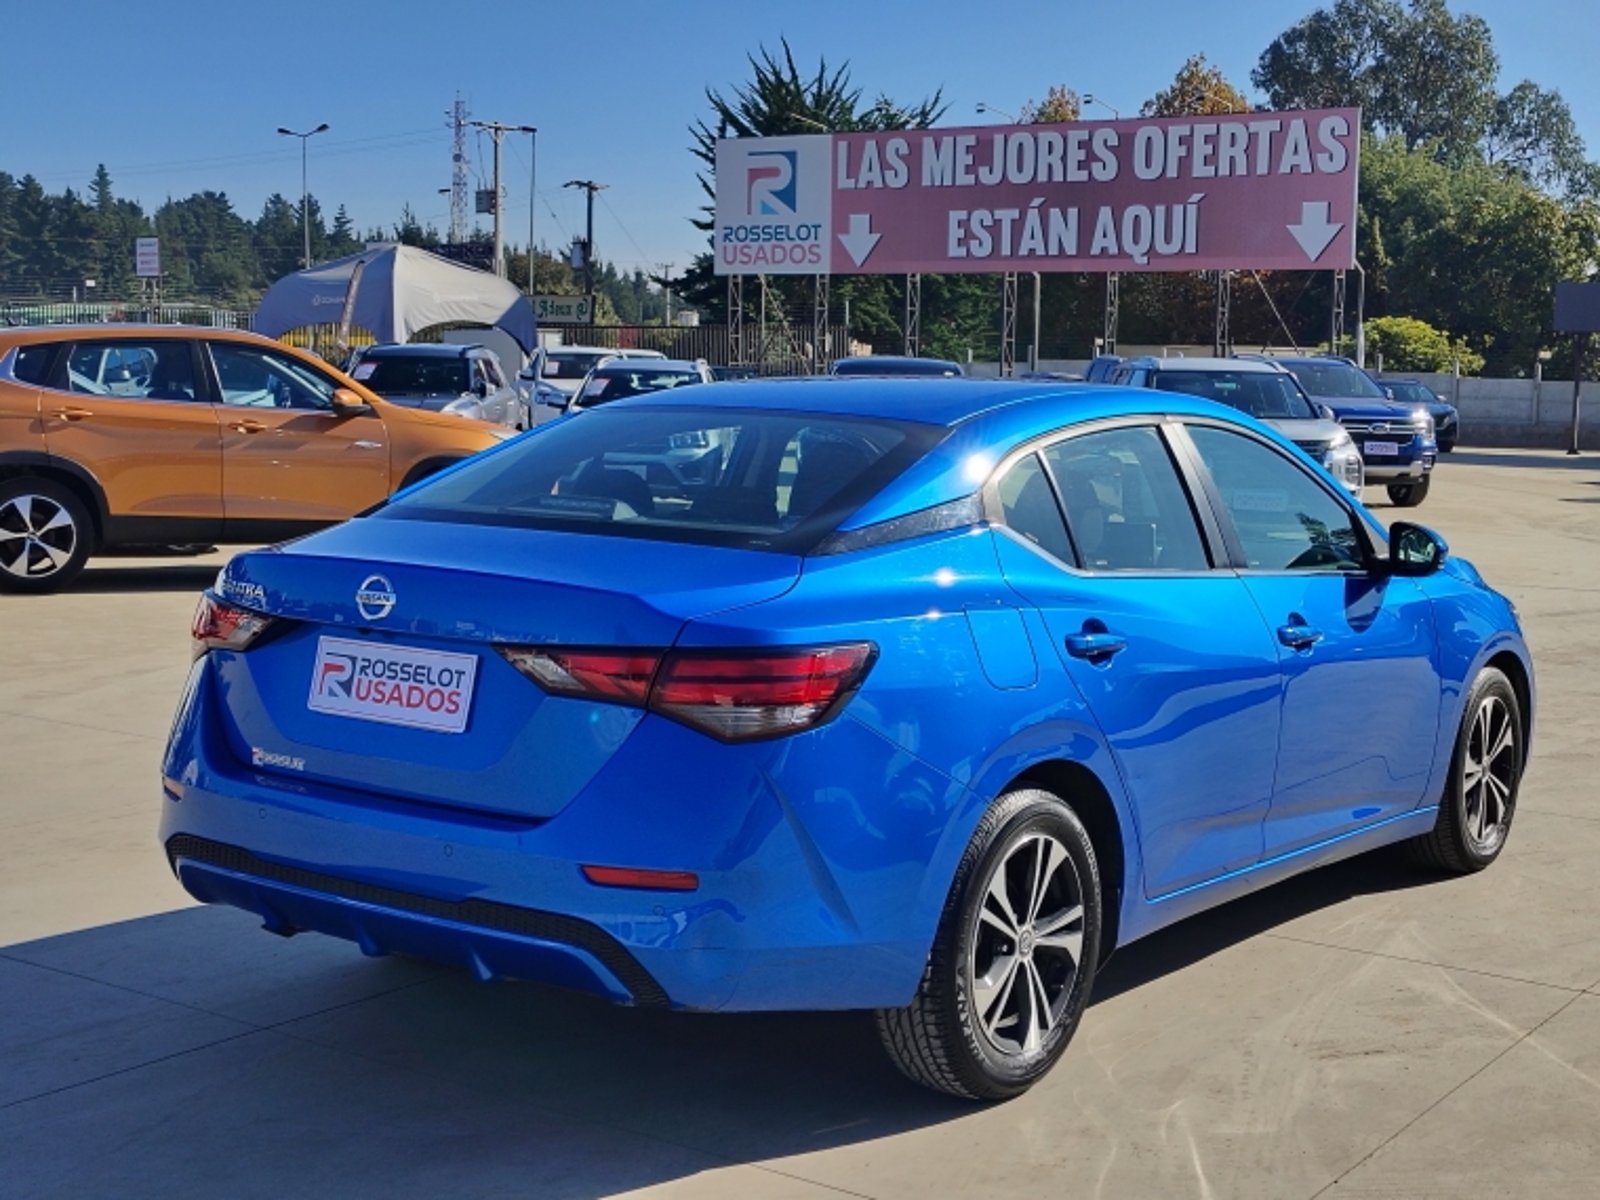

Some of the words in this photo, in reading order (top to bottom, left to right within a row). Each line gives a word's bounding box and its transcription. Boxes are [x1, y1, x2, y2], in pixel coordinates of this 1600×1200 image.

[836, 138, 910, 190] LAS
[921, 125, 1120, 188] MEJORES
[1132, 115, 1349, 180] OFERTAS
[722, 224, 822, 243] ROSSELOT
[947, 196, 1081, 258] ESTÁN
[1090, 192, 1206, 266] AQUÍ
[723, 243, 822, 265] USADOS
[359, 657, 466, 689] ROSSELOT
[355, 678, 462, 715] USADOS
